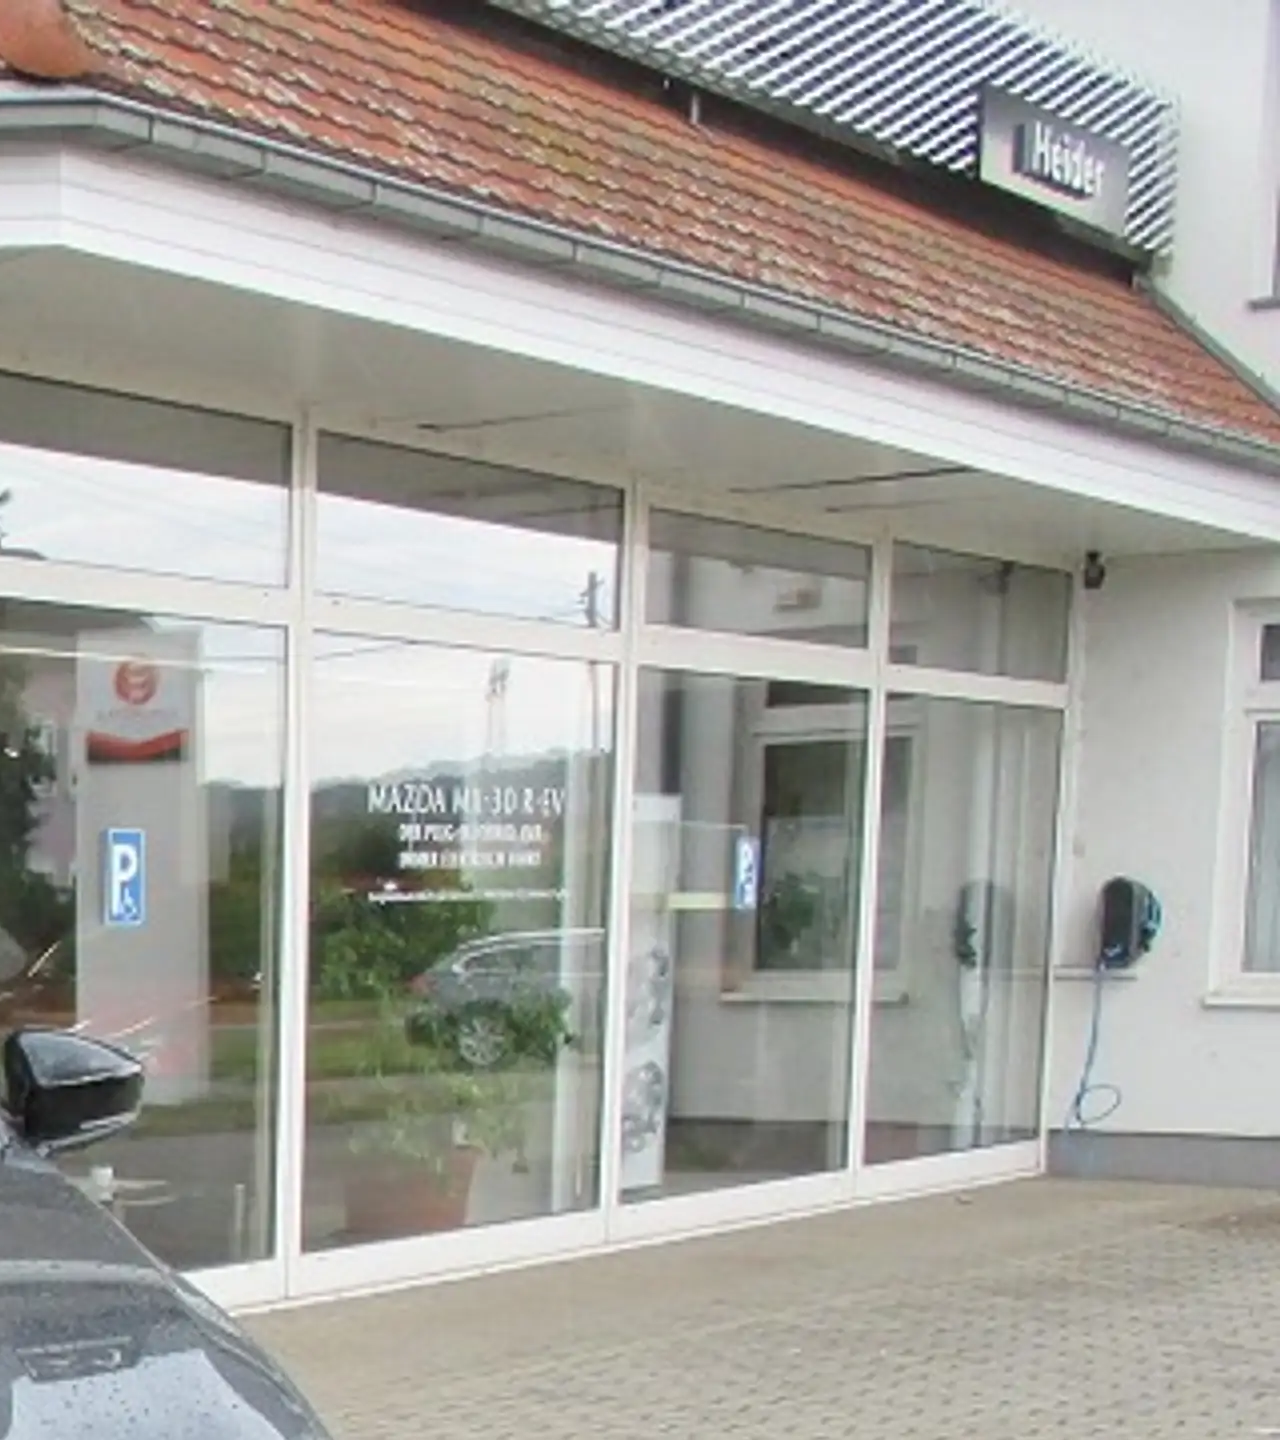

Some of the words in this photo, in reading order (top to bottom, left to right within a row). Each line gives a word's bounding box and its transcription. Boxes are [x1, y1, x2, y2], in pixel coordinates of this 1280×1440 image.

[1030, 120, 1107, 198] Heider
[367, 783, 447, 814] MAZDA
[112, 843, 138, 916] P
